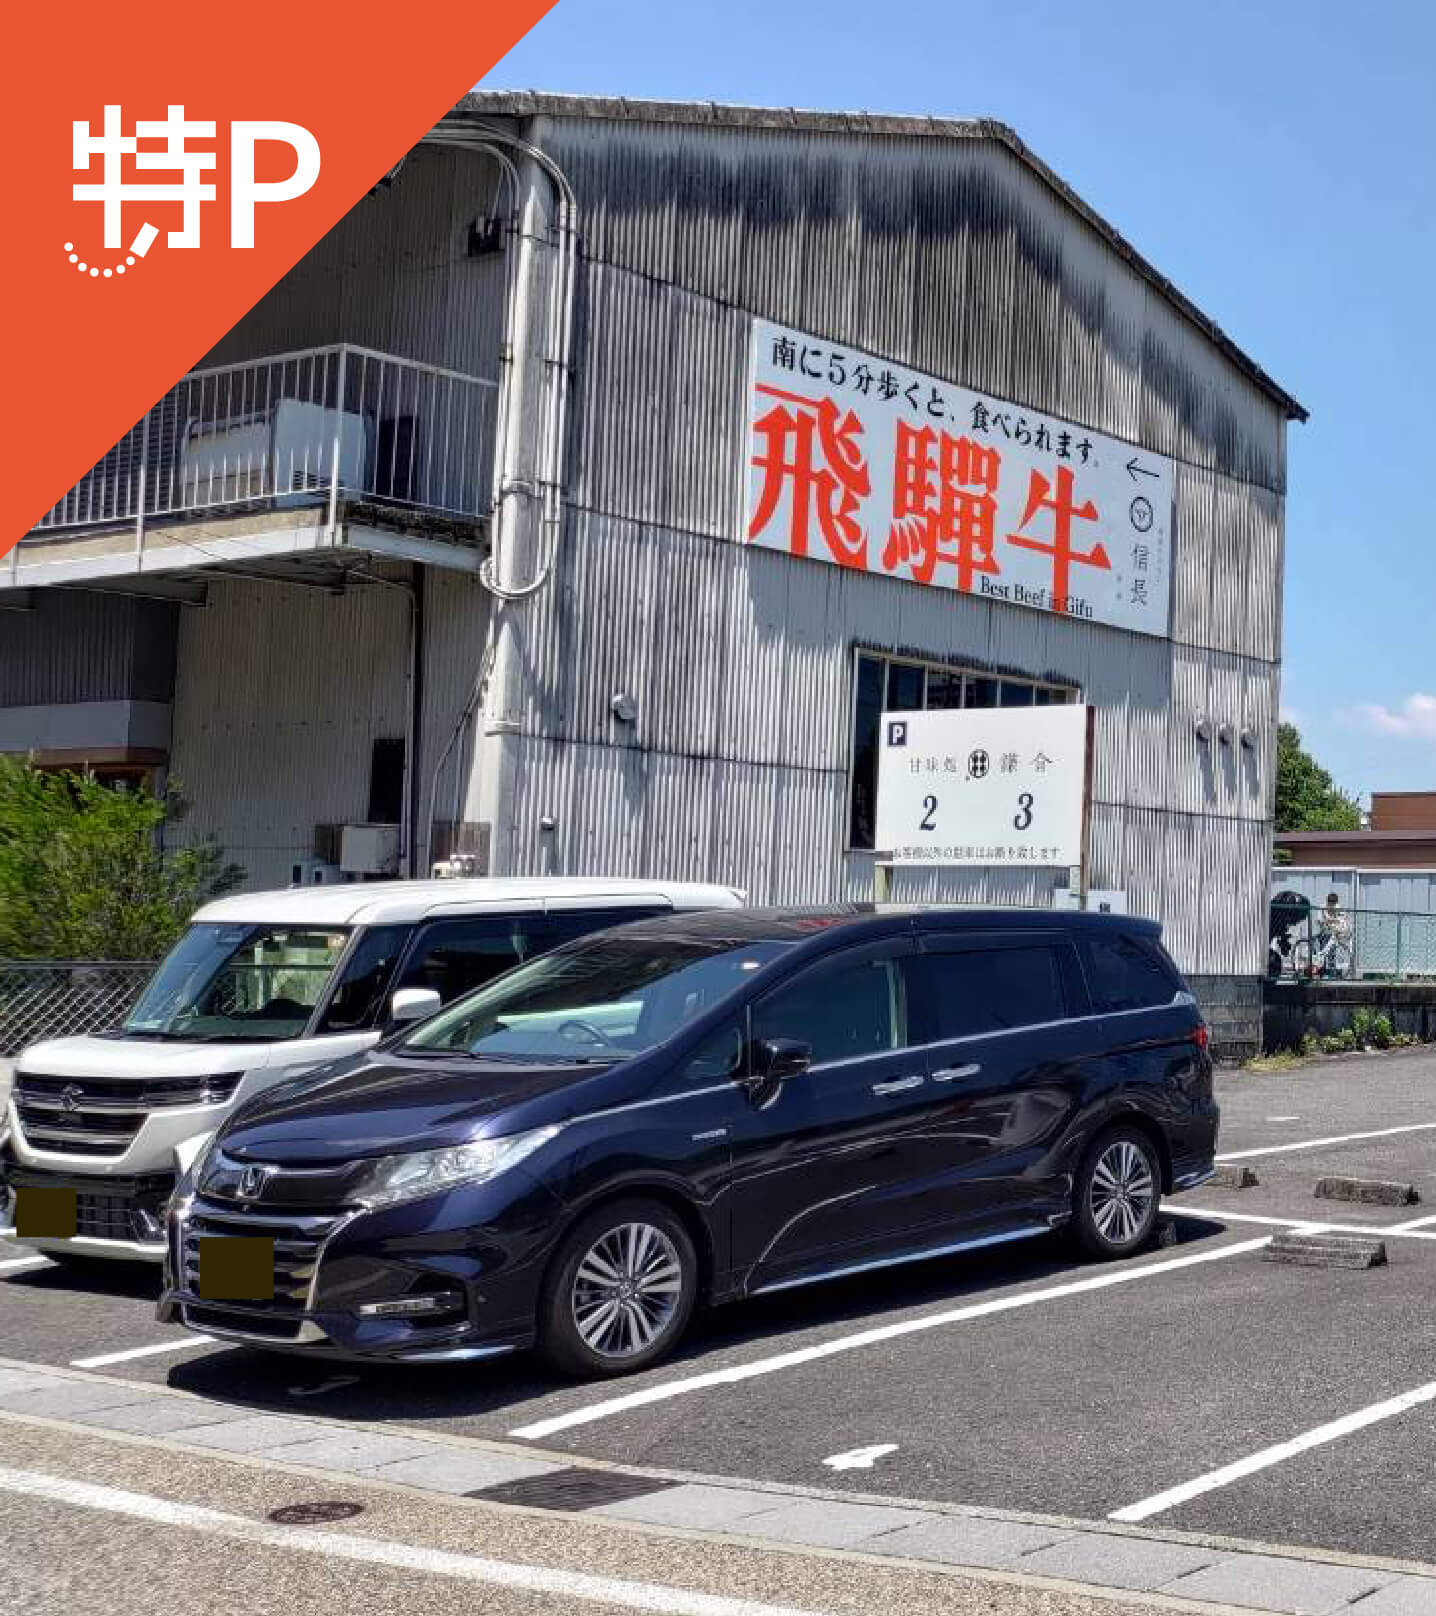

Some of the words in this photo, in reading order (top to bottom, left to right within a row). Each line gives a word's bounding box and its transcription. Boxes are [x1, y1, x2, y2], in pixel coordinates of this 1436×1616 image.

[980, 575, 1010, 599] Best
[1014, 583, 1046, 607] Beef
[1066, 595, 1094, 618] Gifu
[919, 795, 938, 831] 2
[1014, 793, 1034, 831] 3
[822, 1443, 899, 1472] 4
